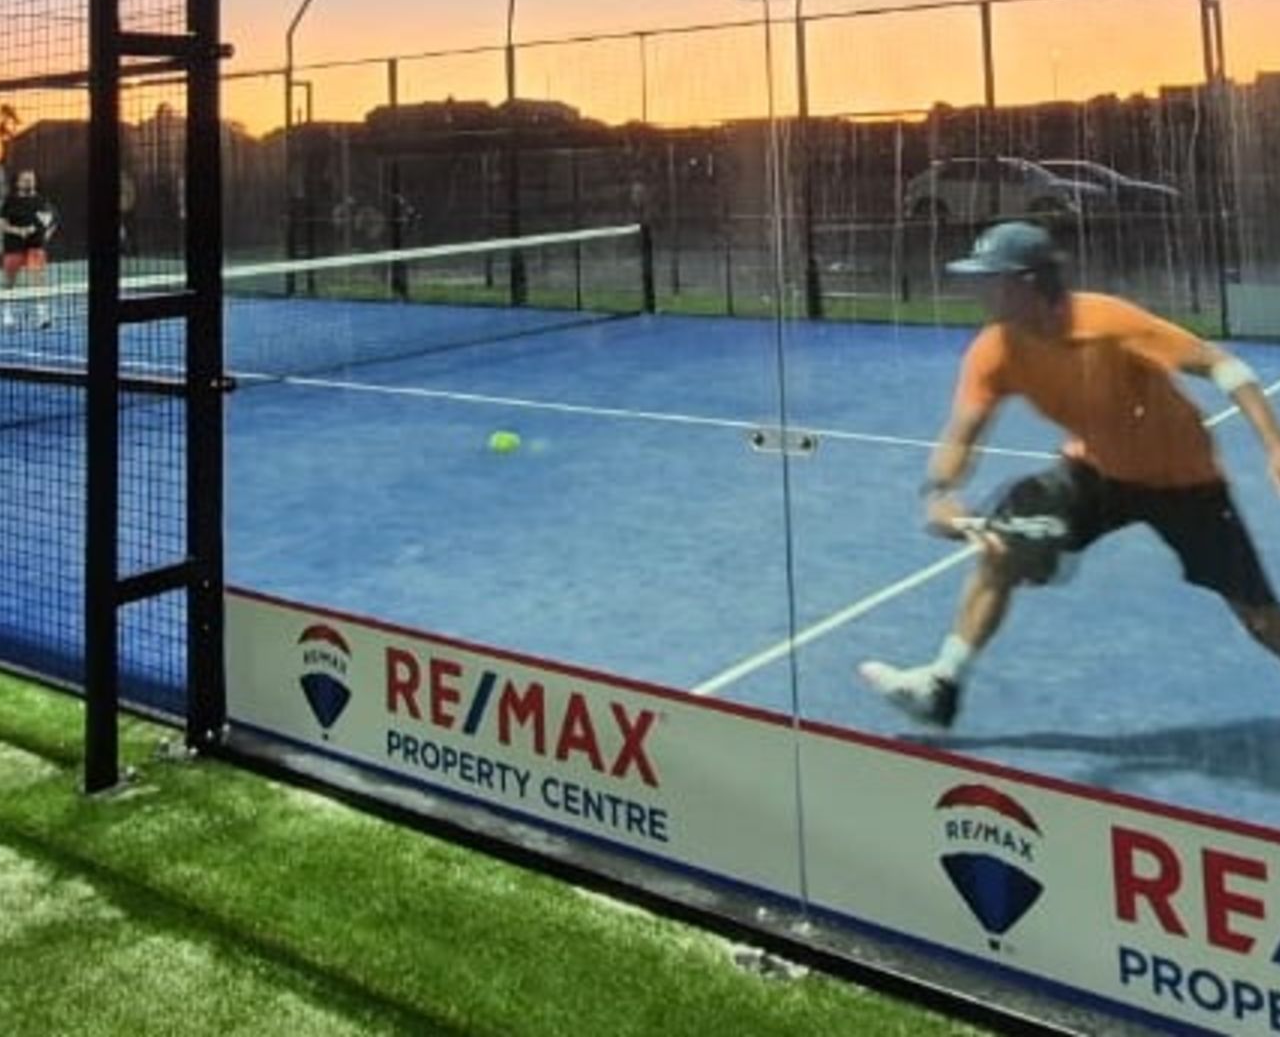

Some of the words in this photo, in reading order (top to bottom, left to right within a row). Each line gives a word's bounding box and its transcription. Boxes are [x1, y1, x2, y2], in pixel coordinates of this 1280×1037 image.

[386, 646, 659, 788] RE/MAX
[386, 729, 531, 798] PROPERTY
[541, 778, 669, 842] CENTRE
[945, 820, 1035, 862] RE/MAX
